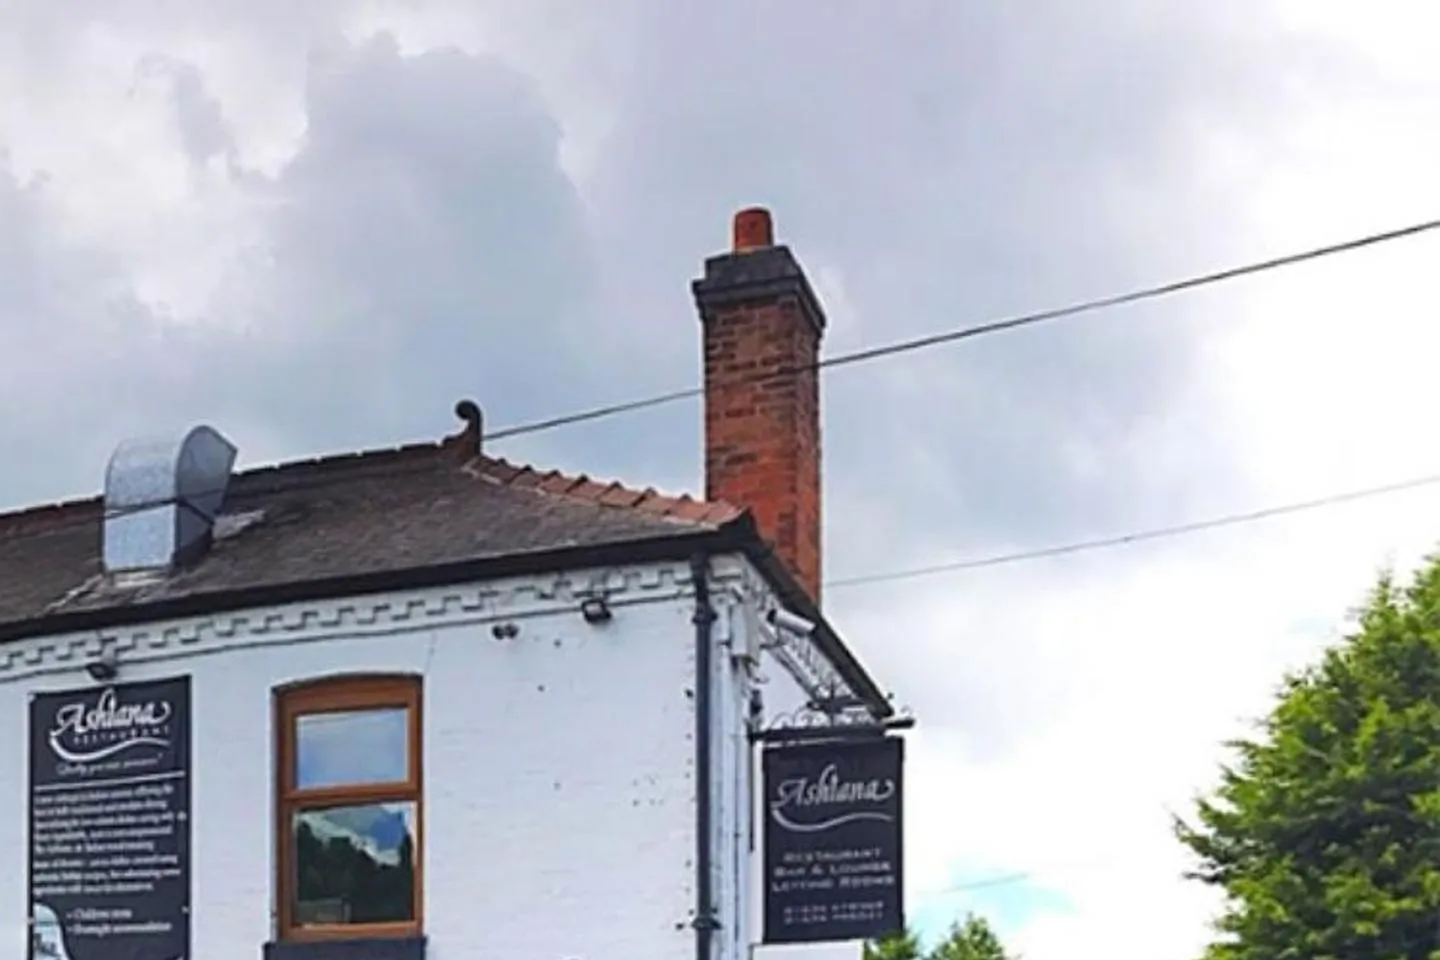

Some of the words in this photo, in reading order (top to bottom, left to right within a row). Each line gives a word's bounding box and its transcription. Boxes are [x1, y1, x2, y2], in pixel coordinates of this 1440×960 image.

[50, 688, 171, 736] Ashiana
[73, 726, 170, 745] RESTAURANT
[770, 763, 895, 808] Ashiana
[782, 848, 882, 863] RESTAURANT
